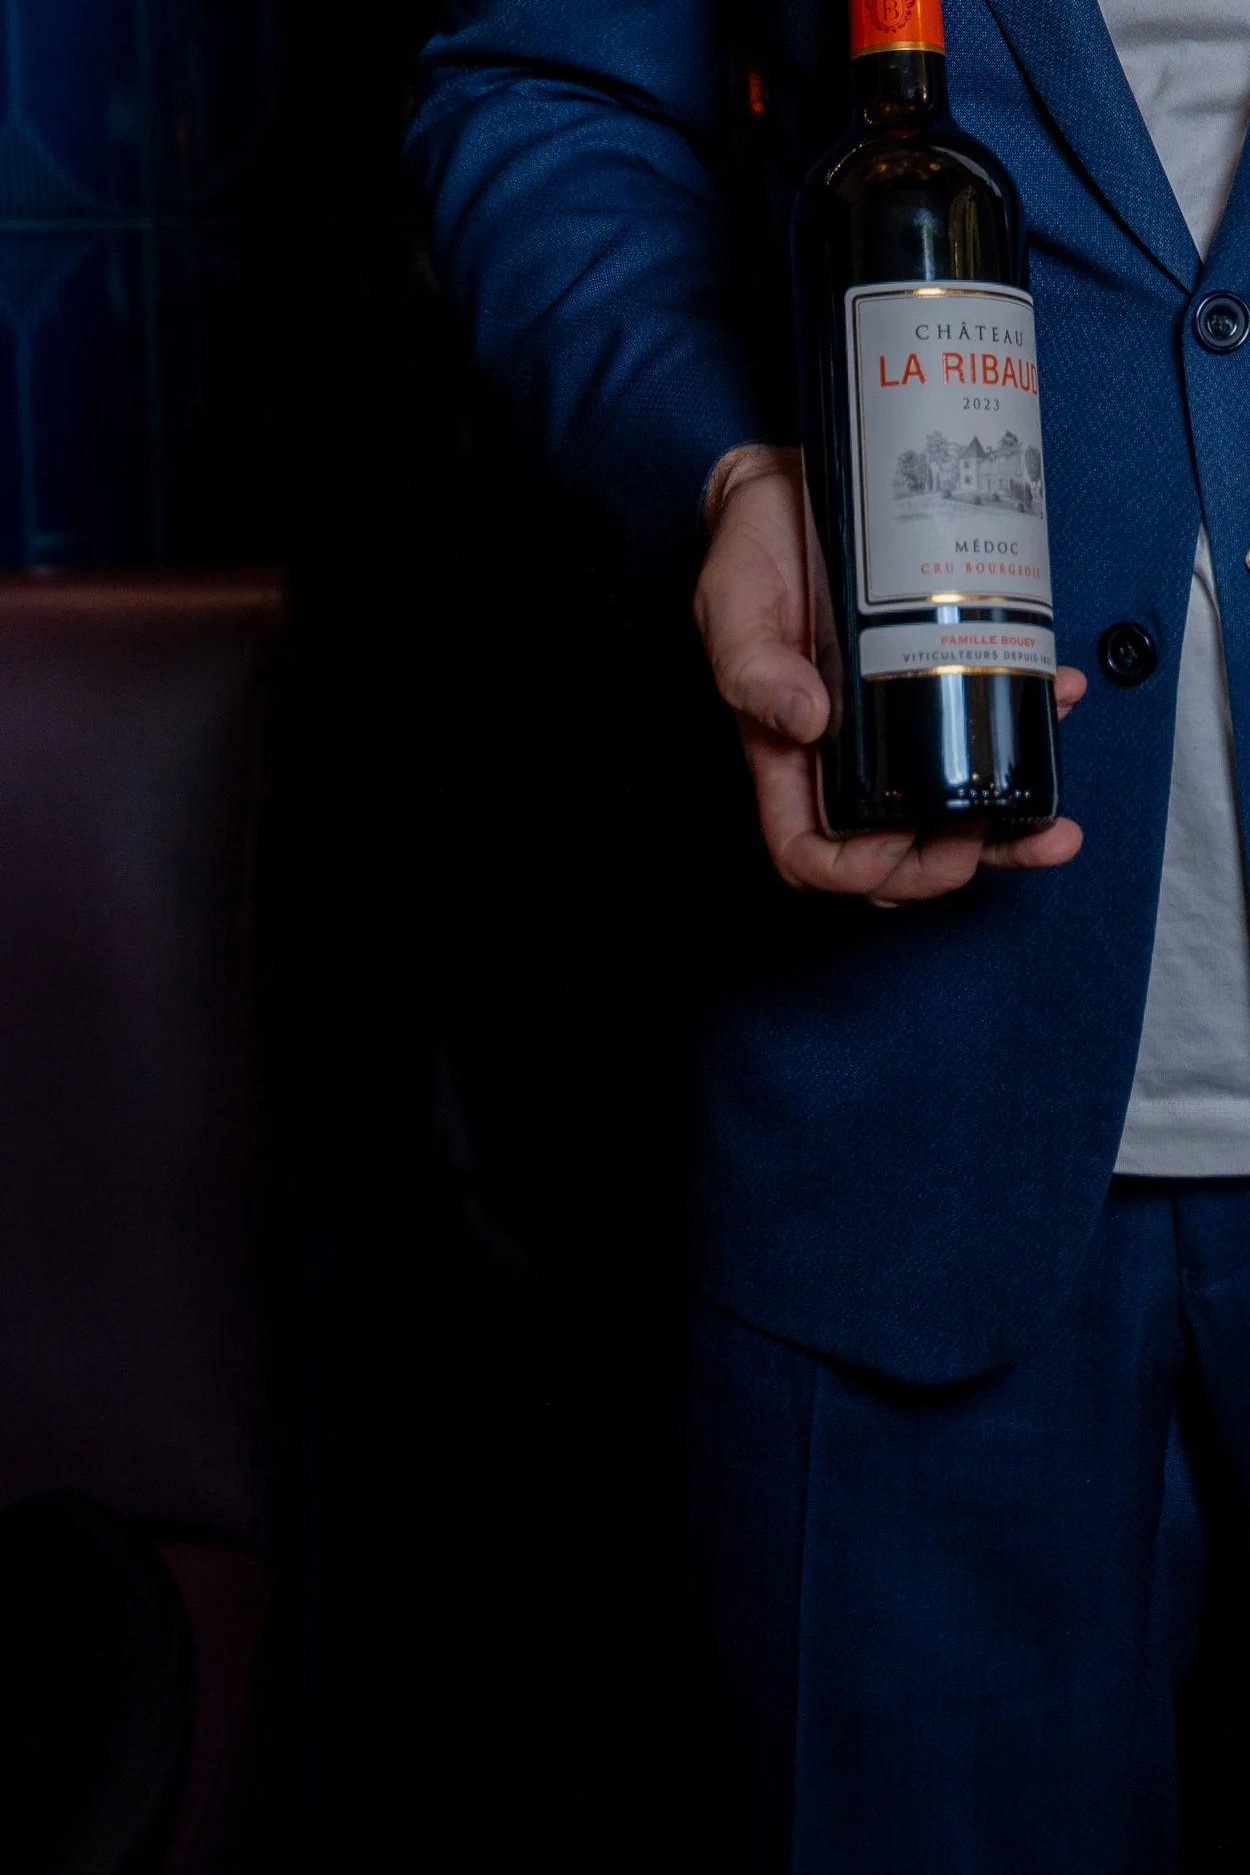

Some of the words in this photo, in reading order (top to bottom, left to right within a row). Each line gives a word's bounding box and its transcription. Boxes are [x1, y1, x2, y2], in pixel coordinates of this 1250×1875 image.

[915, 321, 1023, 347] CHÂTEAU
[879, 352, 926, 387] LA
[963, 397, 1000, 411] 2023
[955, 538, 1020, 555] MÉDOC
[920, 562, 954, 575] CRU
[940, 635, 997, 645] FAMILLE
[1001, 636, 1035, 647] BOUEY
[903, 650, 998, 663] VITICULTEURS
[1003, 651, 1038, 664] DEPUIS
